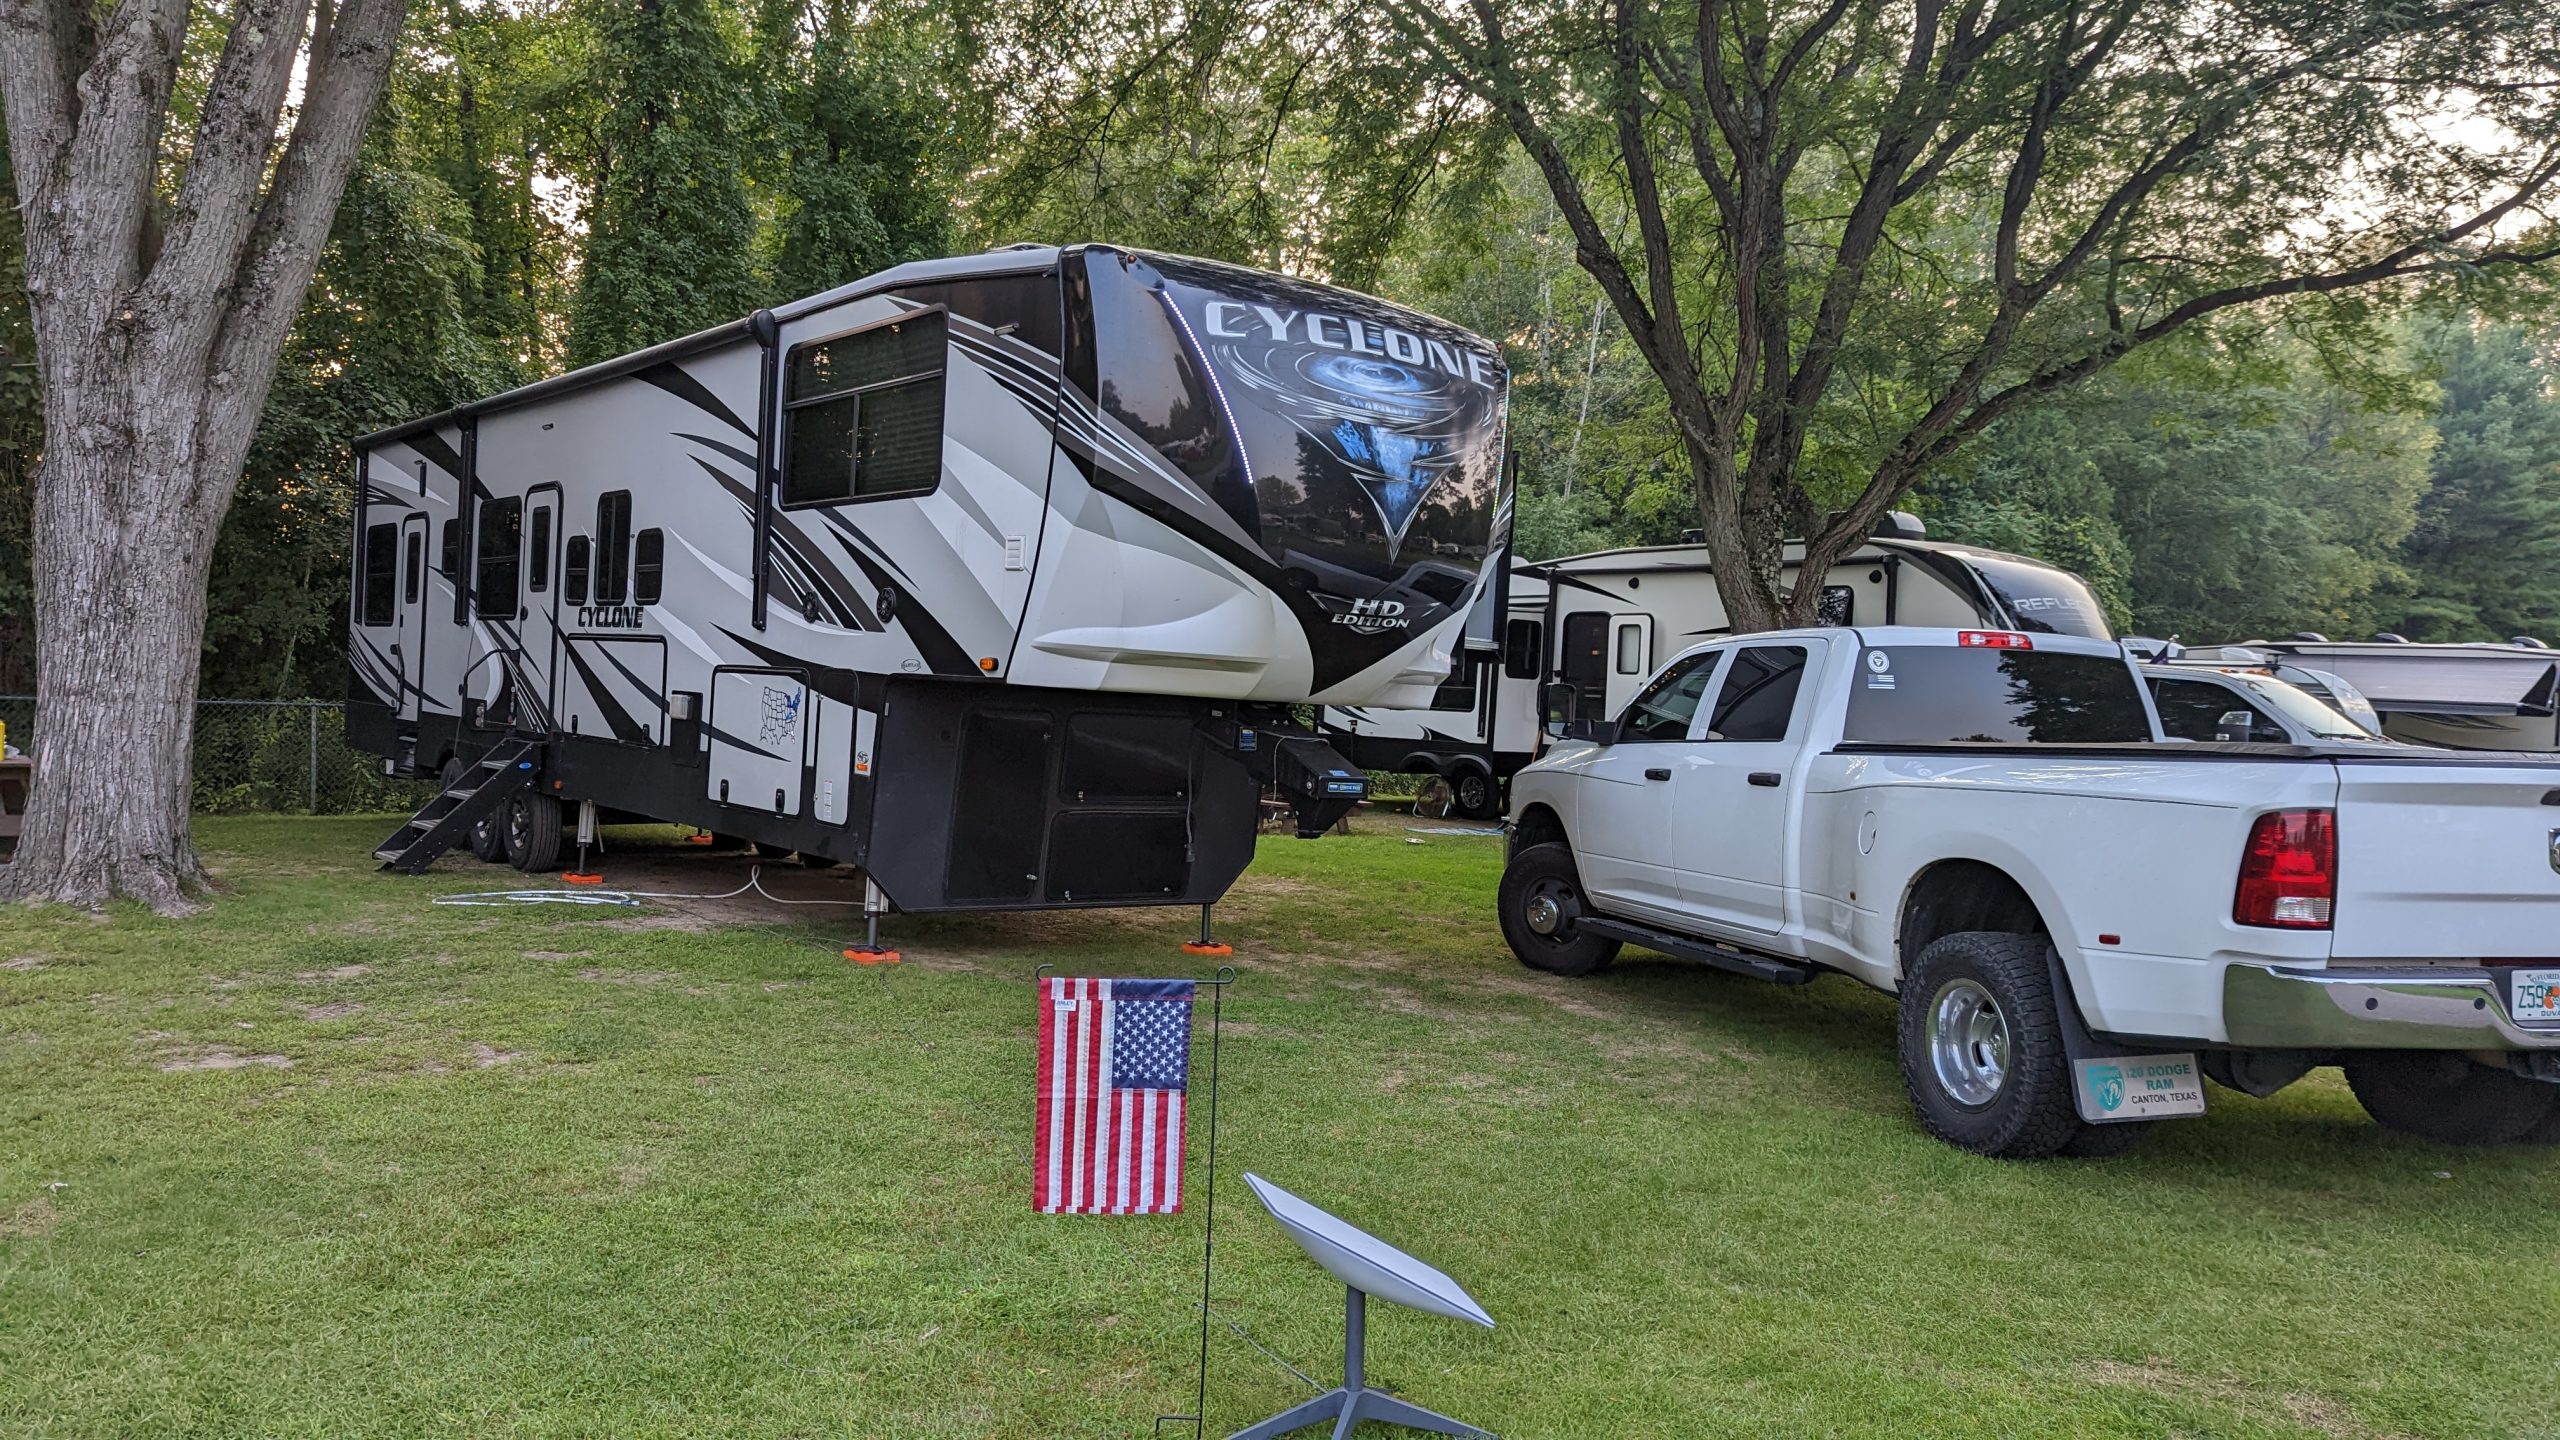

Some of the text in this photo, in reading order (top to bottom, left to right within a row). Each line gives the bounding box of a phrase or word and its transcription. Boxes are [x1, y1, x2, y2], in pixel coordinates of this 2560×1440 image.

[1205, 301, 1495, 390] CYCLONE
[1350, 598, 1405, 617] HD
[578, 606, 644, 628] CYCLONE
[1331, 613, 1410, 628] EDITION
[2147, 1064, 2191, 1077] DODGE
[2146, 1079, 2174, 1090] RAM
[2131, 1092, 2197, 1104] CANTON, TEXAS
